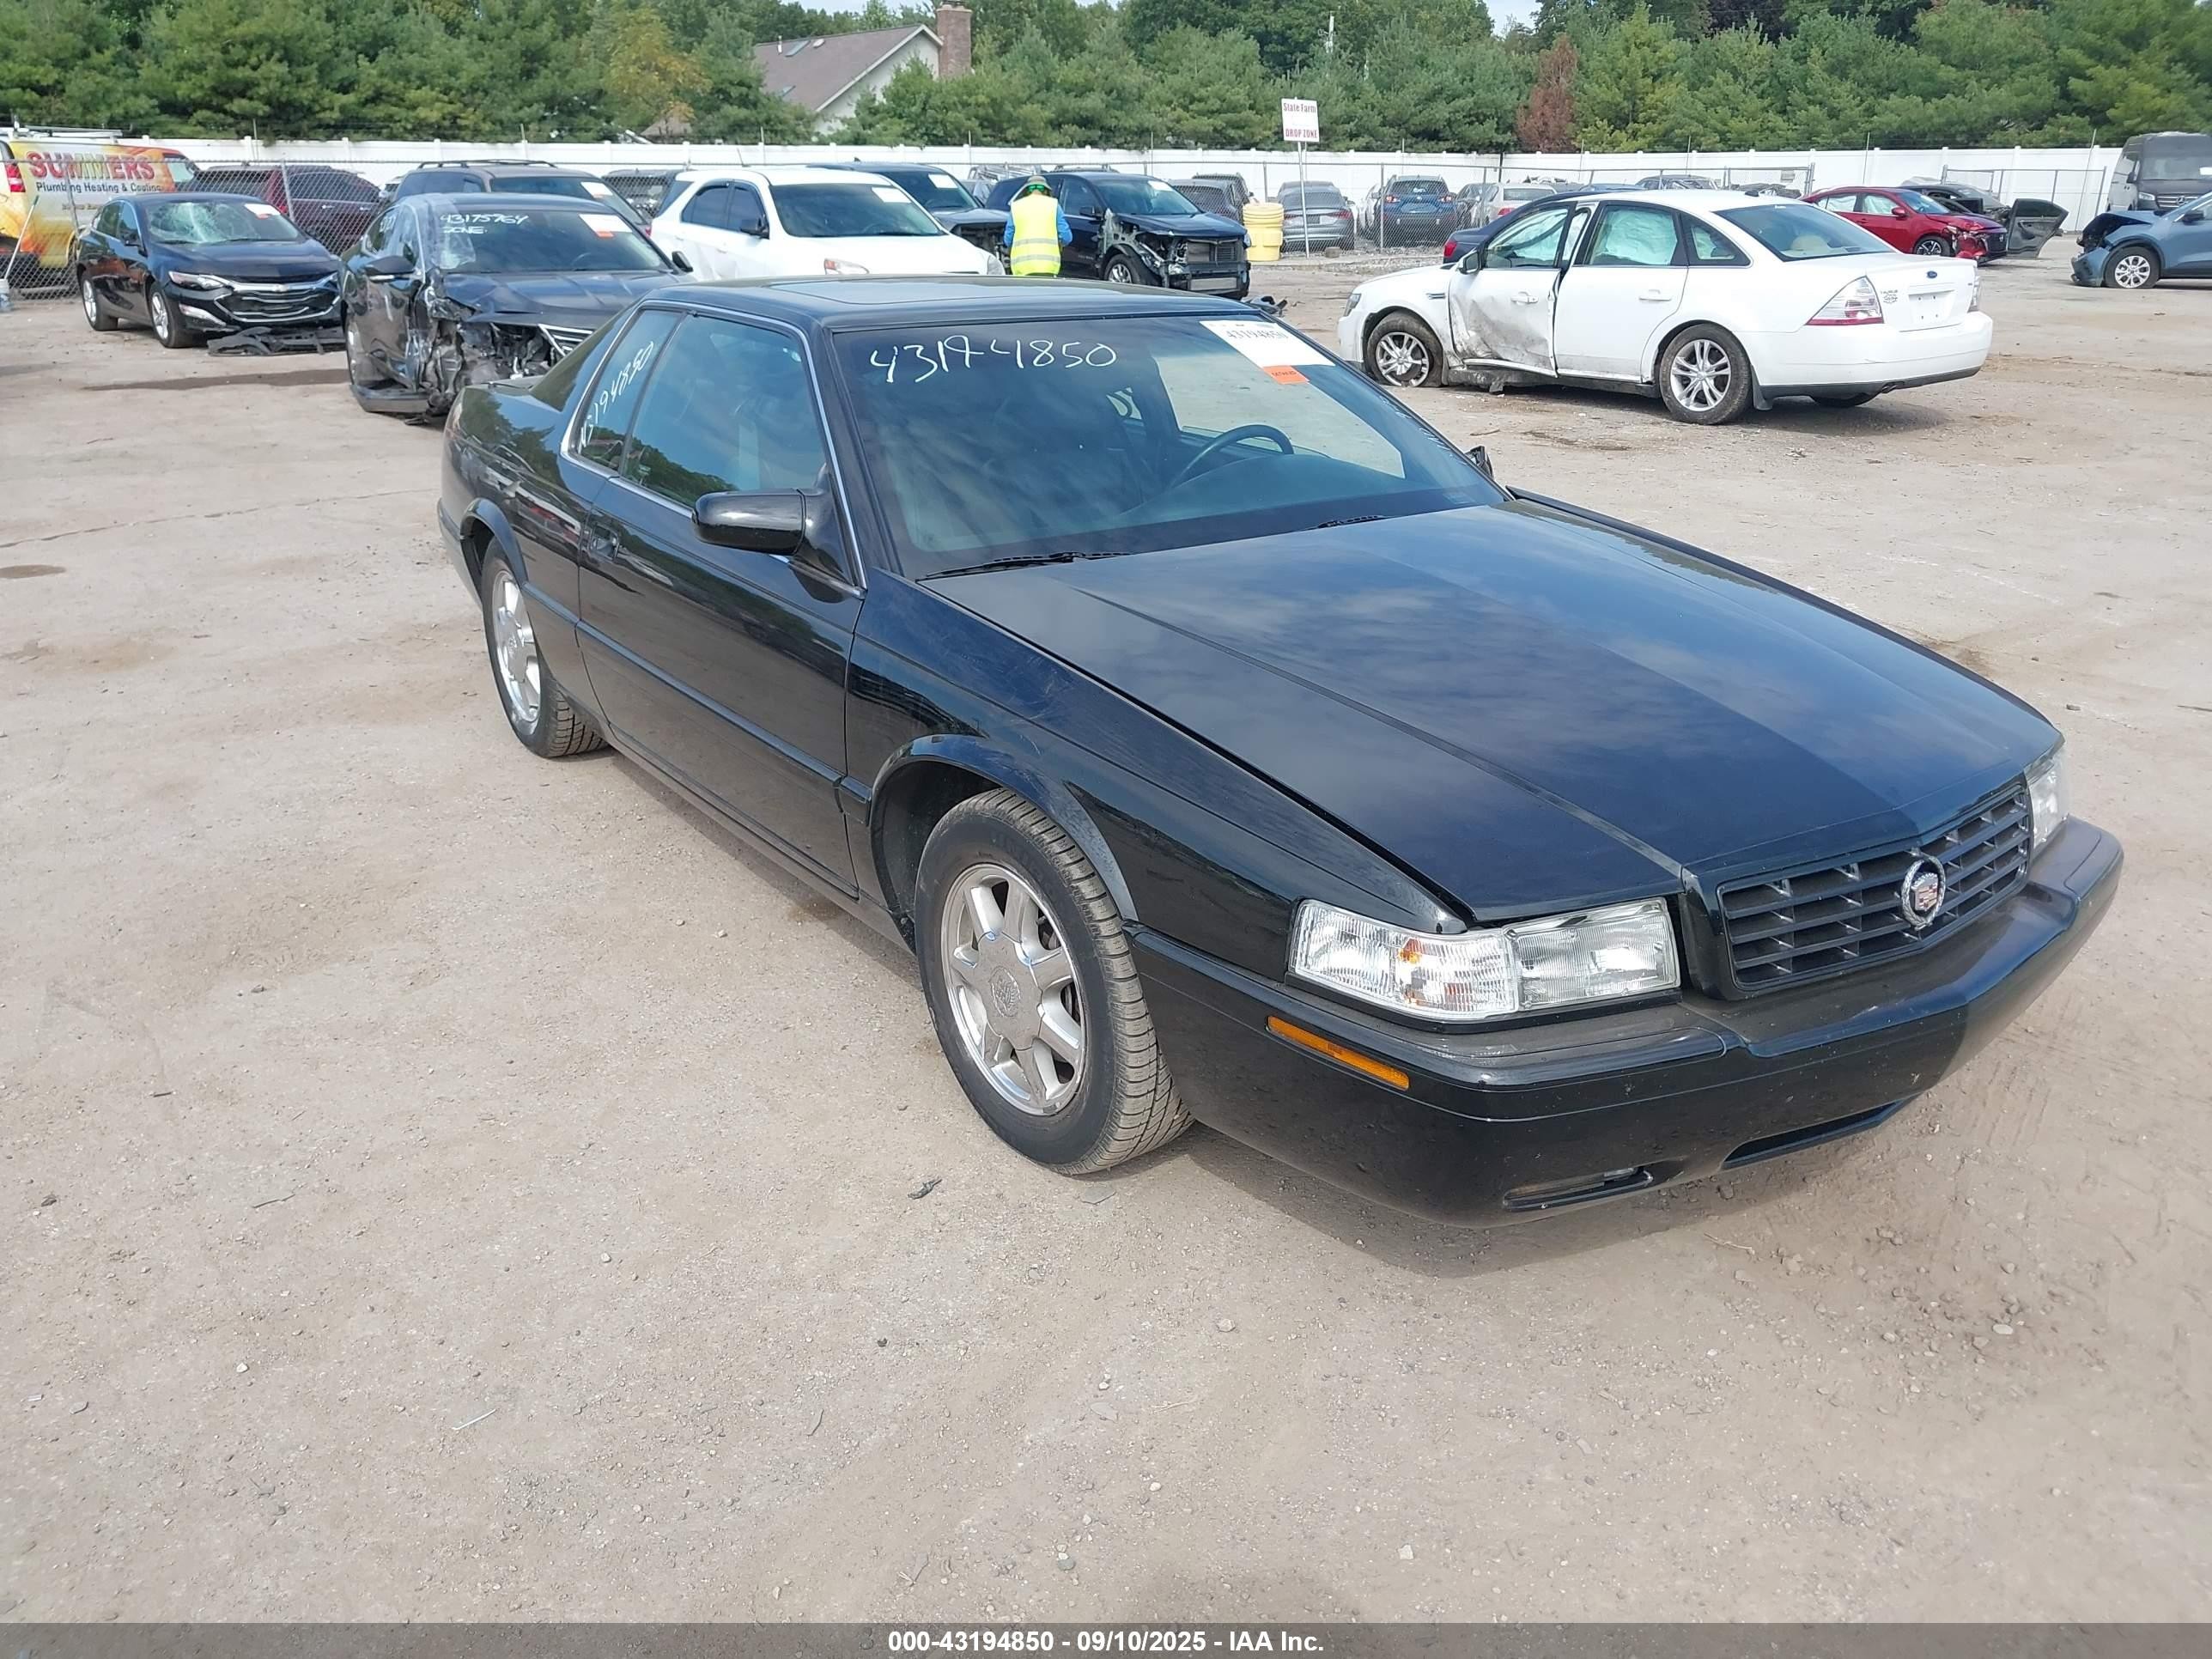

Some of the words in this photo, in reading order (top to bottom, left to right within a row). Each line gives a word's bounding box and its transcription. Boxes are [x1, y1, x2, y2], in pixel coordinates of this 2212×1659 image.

[1283, 102, 1299, 112] State
[1300, 103, 1316, 112] Farm
[1285, 128, 1302, 137] DROP
[1303, 129, 1317, 138] ZONE
[27, 151, 155, 179] SUMMERS
[36, 182, 82, 193] Plumbng
[84, 182, 118, 193] Heating
[121, 183, 128, 191] &
